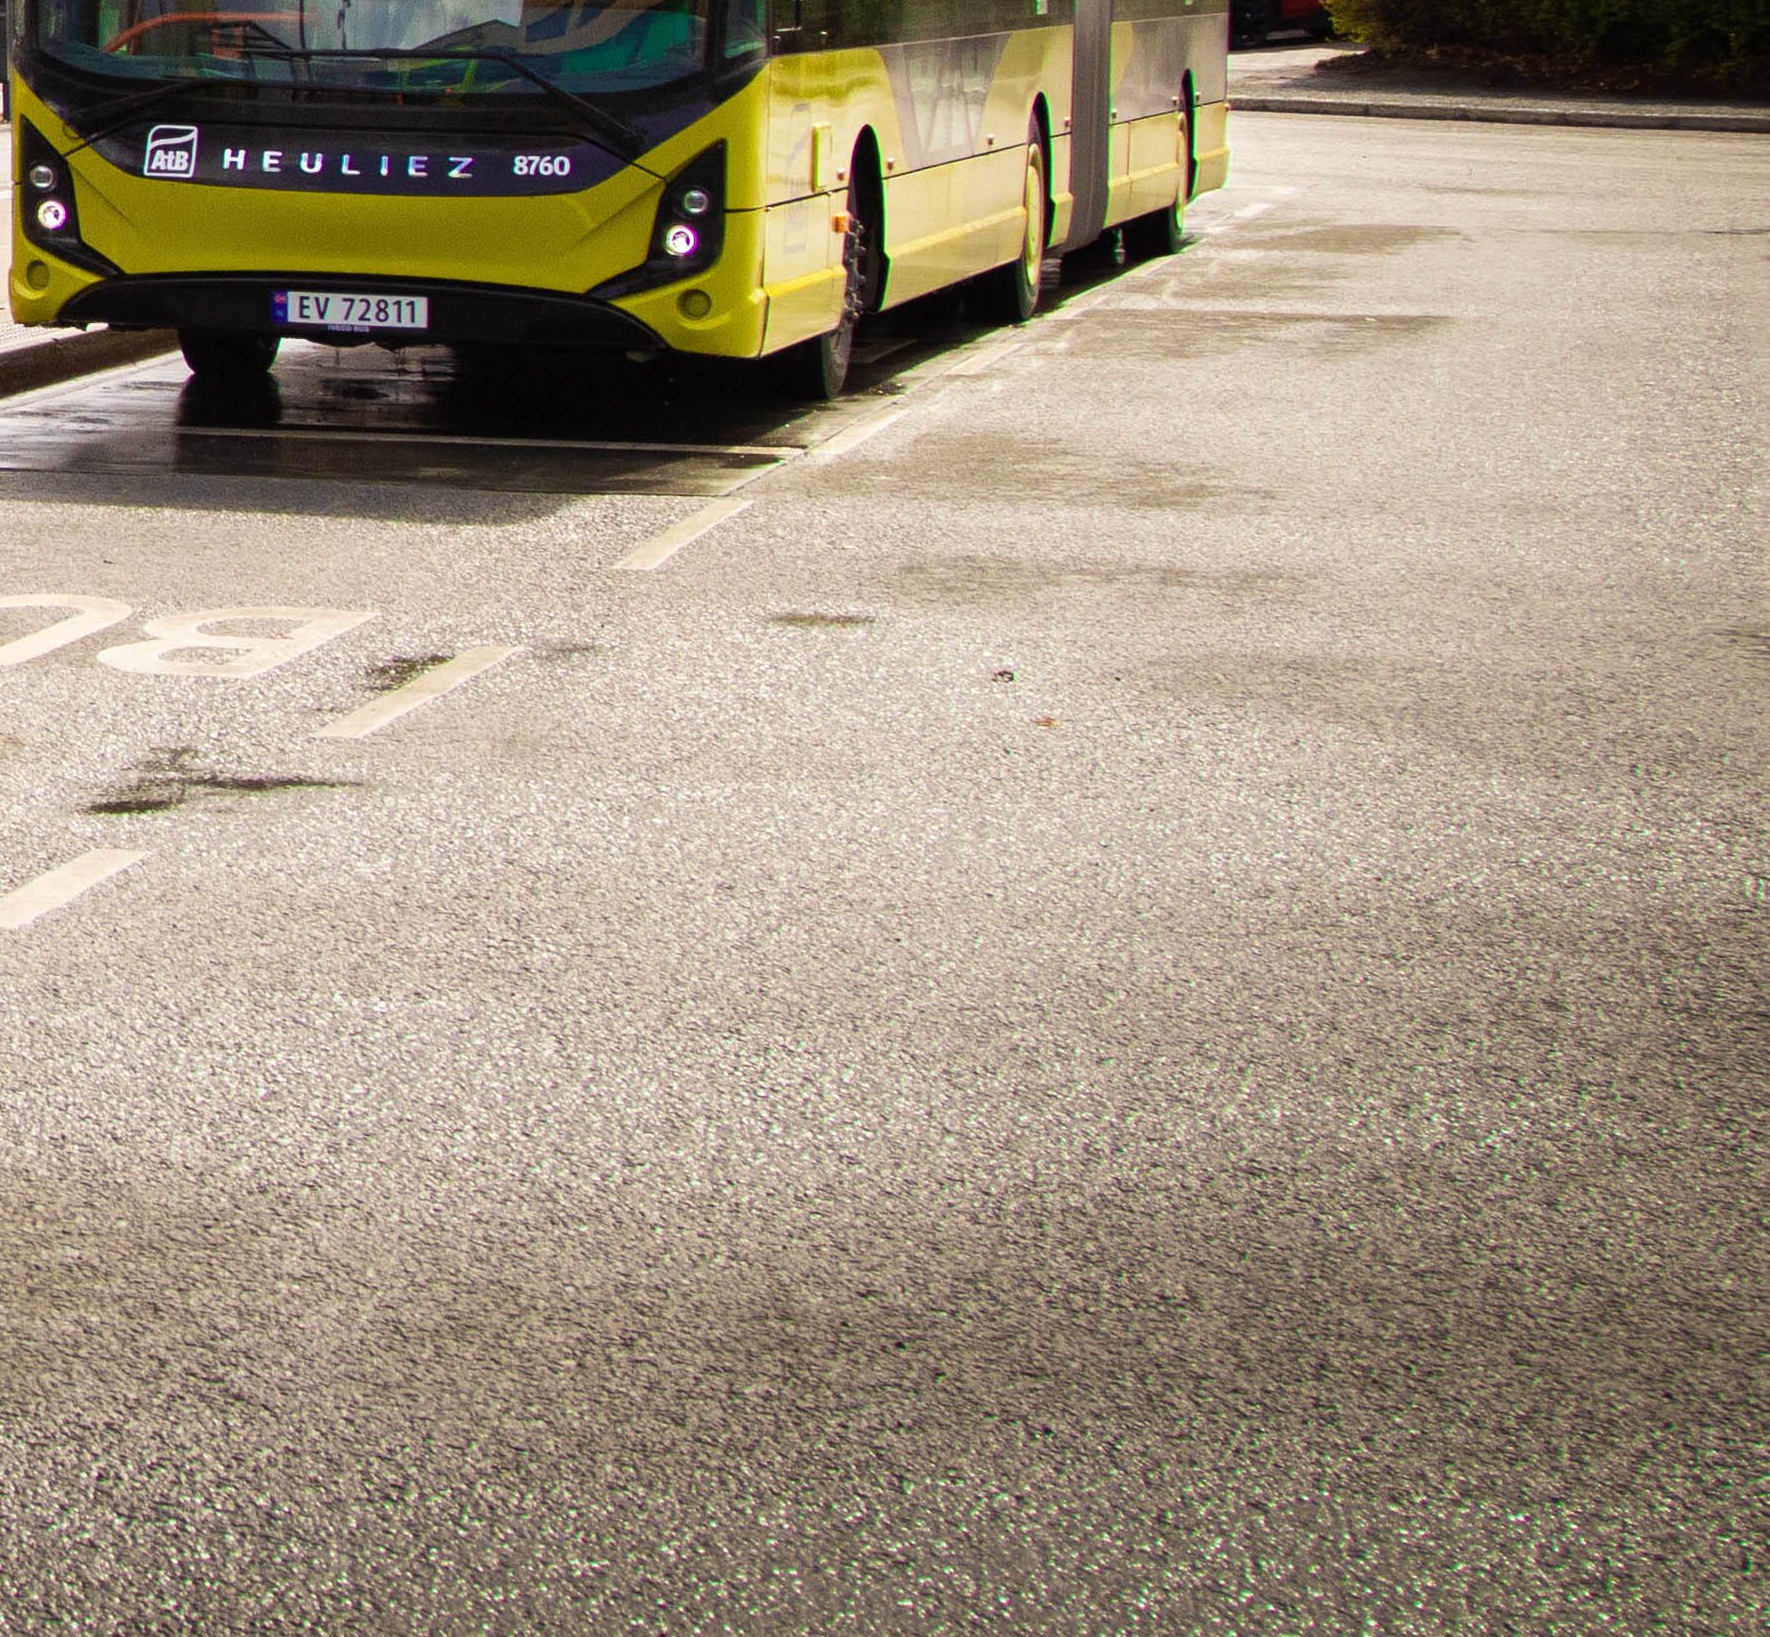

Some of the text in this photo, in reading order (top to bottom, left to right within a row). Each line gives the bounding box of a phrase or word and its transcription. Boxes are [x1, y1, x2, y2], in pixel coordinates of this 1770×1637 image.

[151, 149, 190, 172] AtB
[223, 148, 473, 178] HEULIEZ
[513, 155, 571, 177] 8760
[299, 295, 418, 324] EV 72811
